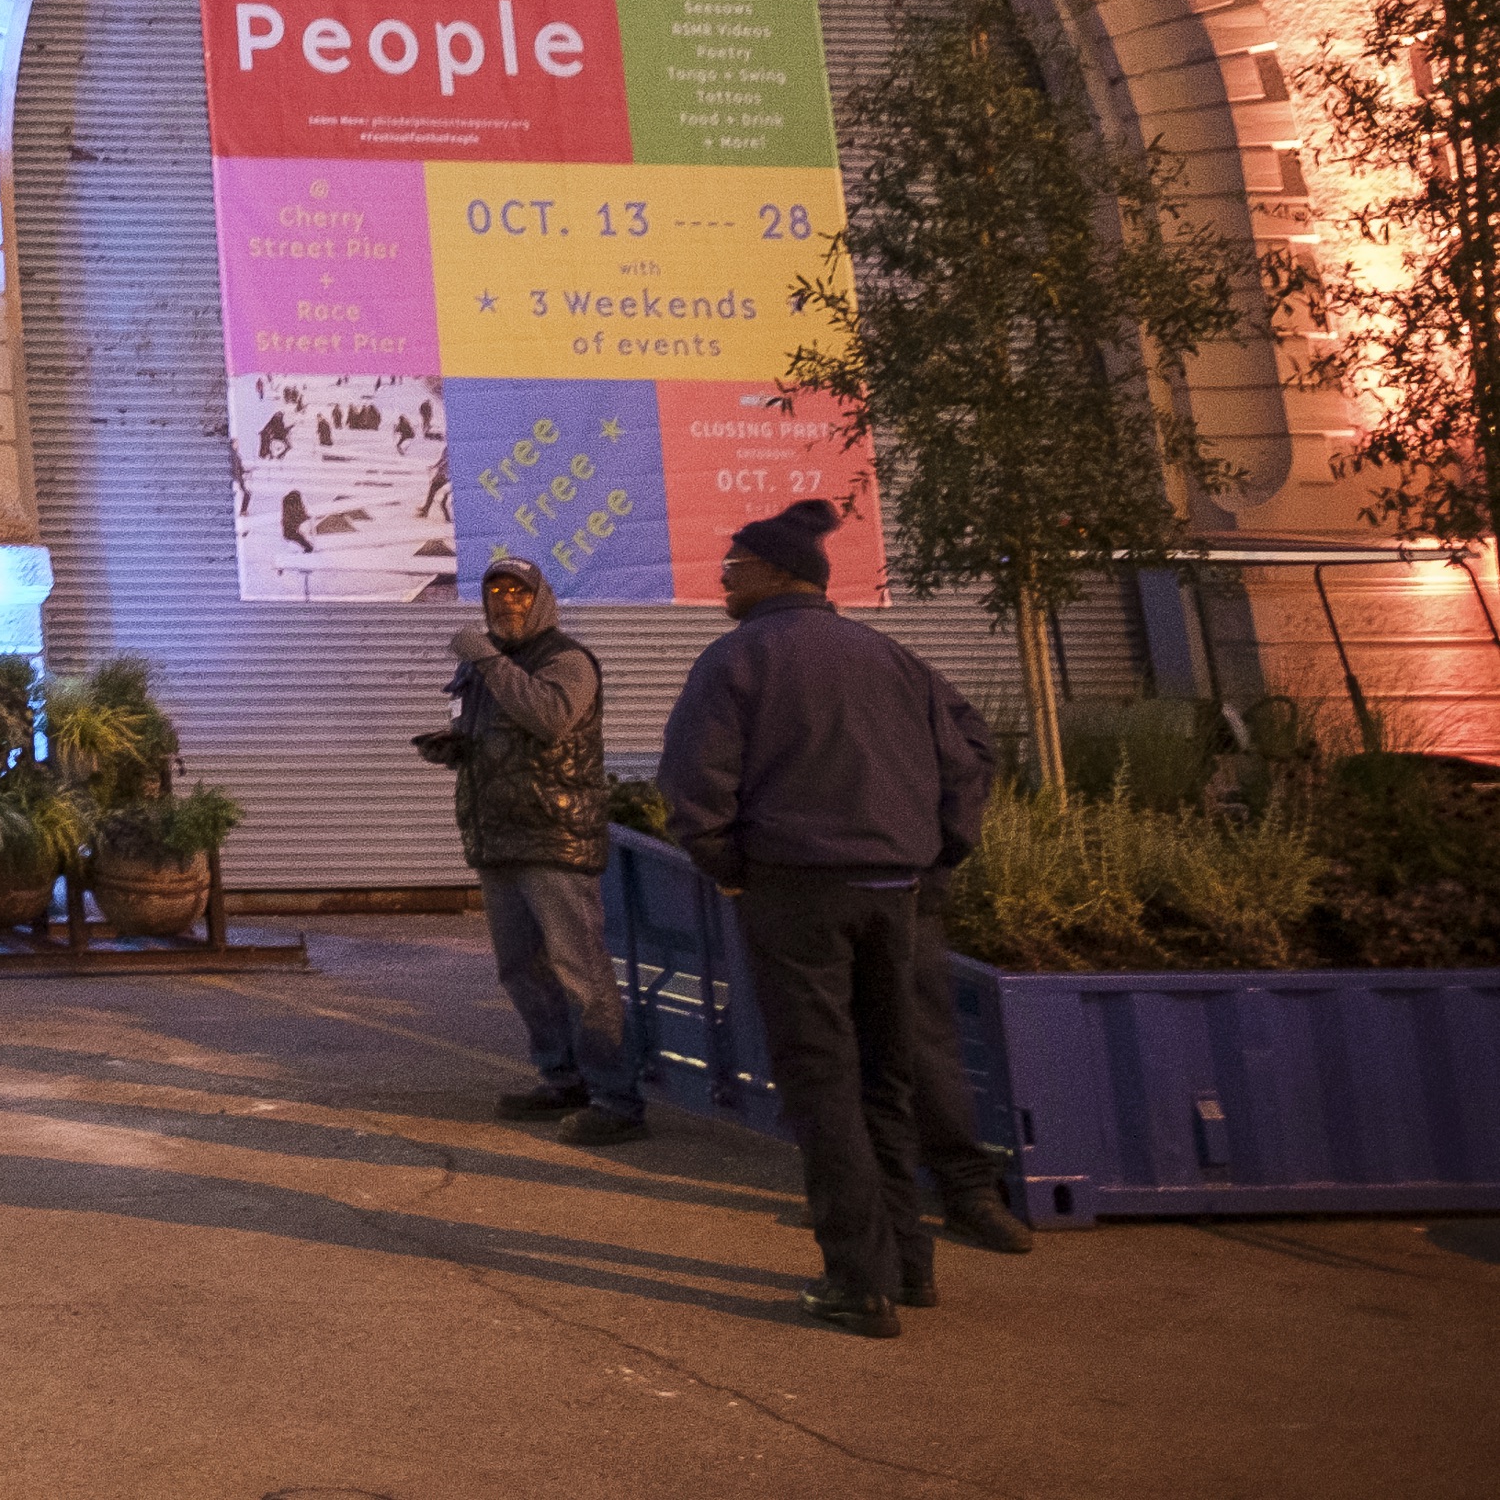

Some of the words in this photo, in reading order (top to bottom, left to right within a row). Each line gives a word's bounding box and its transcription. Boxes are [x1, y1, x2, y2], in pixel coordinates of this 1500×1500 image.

[717, 23, 771, 38] Videos
[696, 45, 751, 62] Poetry
[667, 67, 718, 84] Tango
[739, 68, 786, 86] Swing
[680, 112, 720, 127] Food
[741, 113, 783, 128] Drink
[279, 205, 365, 233] Cherry
[467, 200, 570, 236] OCT.
[597, 201, 650, 237] 13
[759, 204, 813, 241] 28
[251, 237, 334, 260] Street
[347, 237, 399, 260] Pier
[619, 260, 662, 277] with
[298, 299, 361, 322] Race
[530, 289, 549, 317] 3
[564, 288, 757, 320] Weekends
[256, 329, 341, 353] Street
[354, 329, 406, 353] Pier
[571, 331, 604, 356] of
[618, 333, 722, 357] events
[689, 420, 774, 439] CLOSING
[780, 421, 832, 439] PART
[478, 418, 560, 501] Free
[716, 468, 777, 494] OCT.
[789, 469, 823, 494] 27
[514, 453, 596, 537] Free
[552, 488, 634, 574] Free
